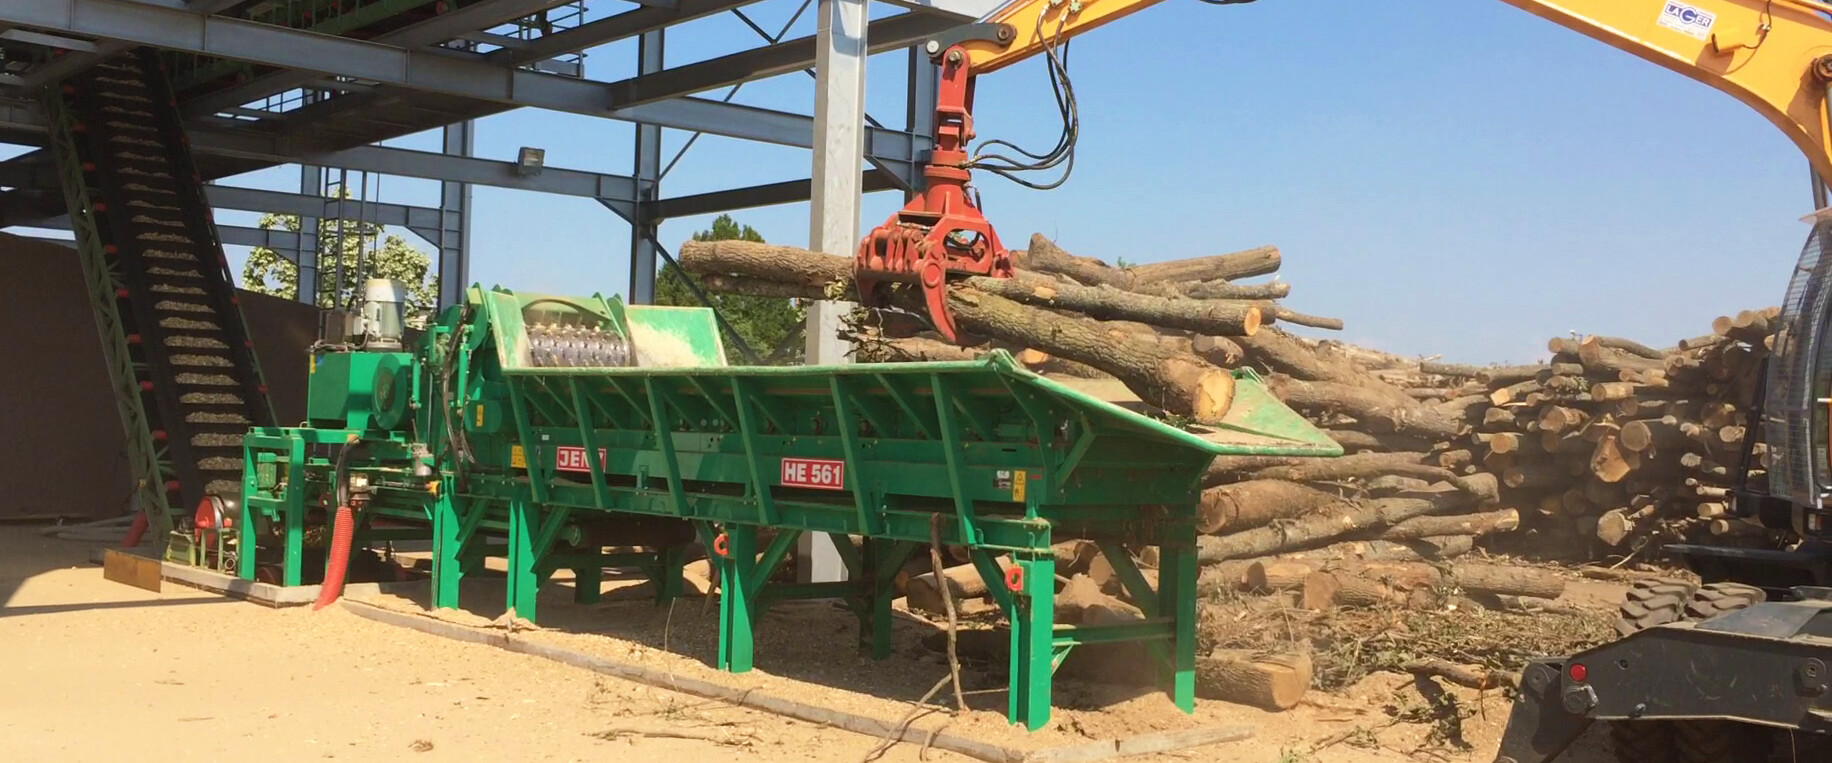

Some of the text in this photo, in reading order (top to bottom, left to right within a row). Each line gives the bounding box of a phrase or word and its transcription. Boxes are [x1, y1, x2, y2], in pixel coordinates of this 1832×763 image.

[1666, 4, 1710, 27] LAGER
[559, 450, 604, 468] JEN
[784, 462, 841, 485] HE 561
